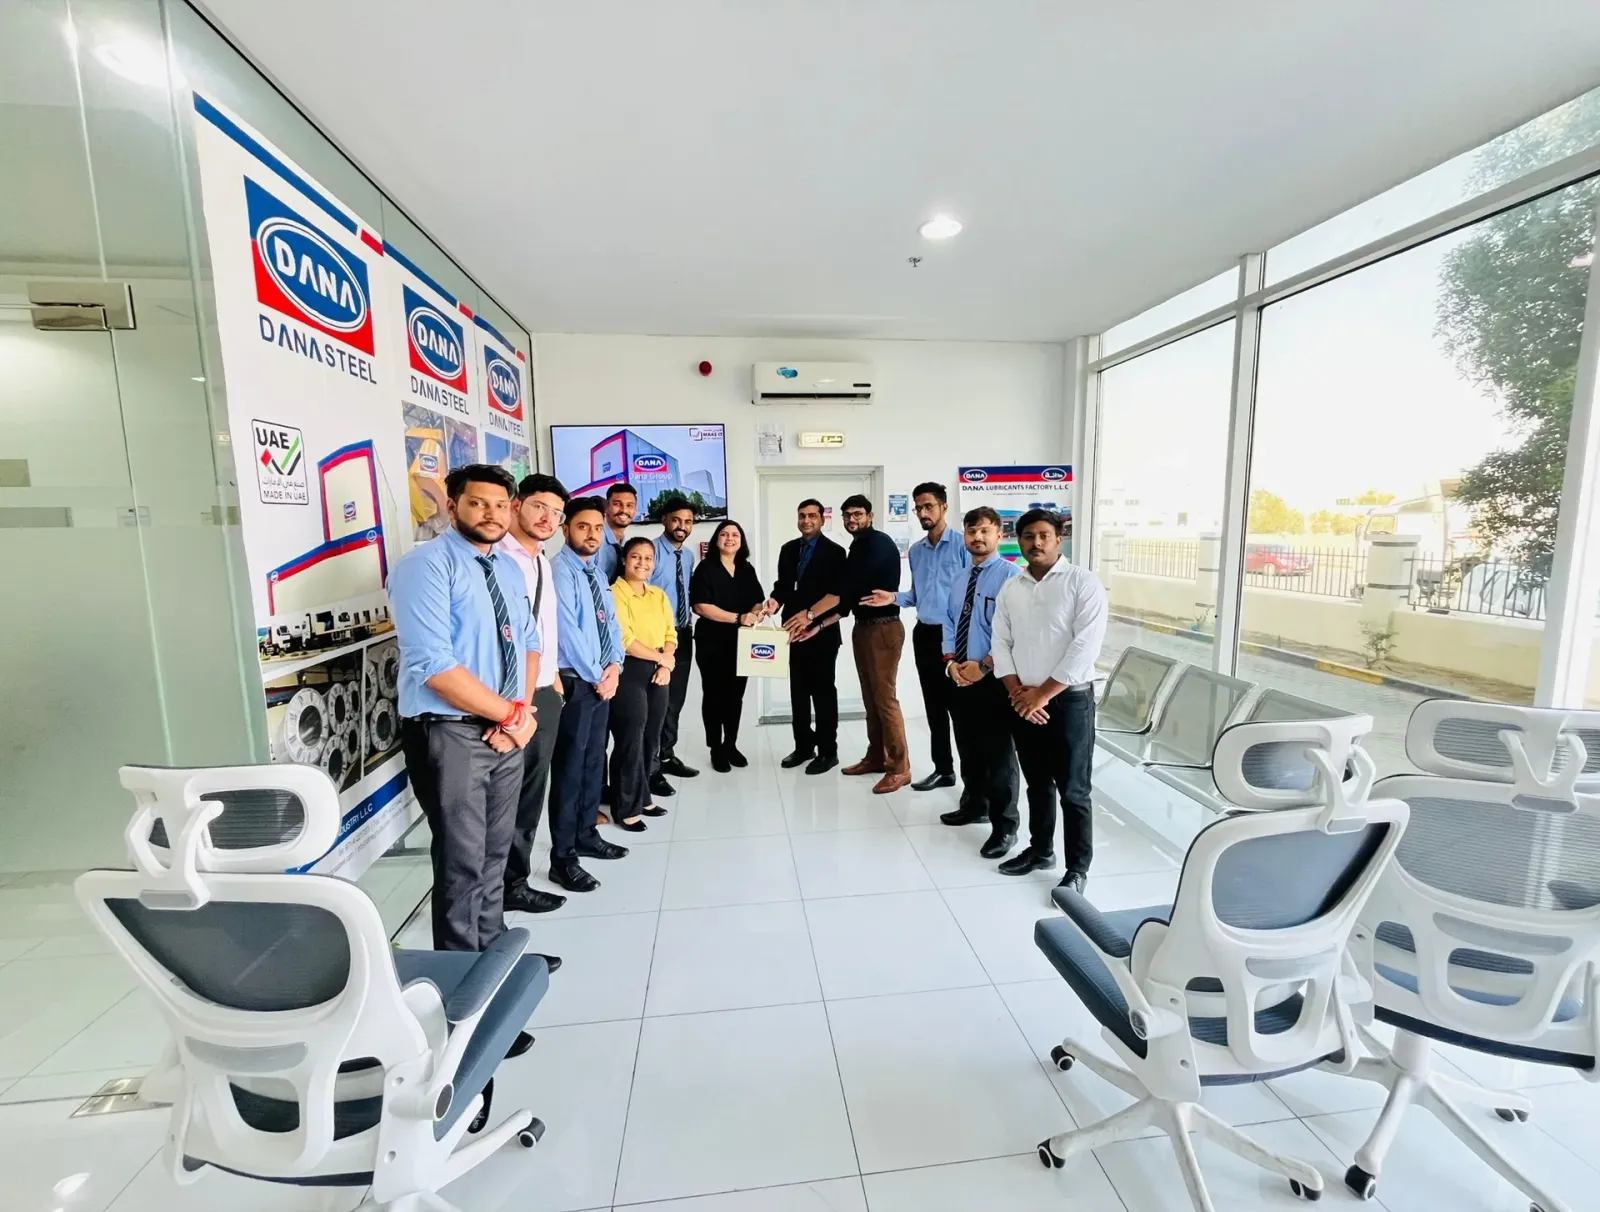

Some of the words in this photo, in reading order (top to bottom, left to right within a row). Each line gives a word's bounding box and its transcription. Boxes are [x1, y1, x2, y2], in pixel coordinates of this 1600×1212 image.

[274, 236, 357, 314] DANA
[417, 320, 459, 366] DANA
[255, 427, 290, 450] UAE
[649, 473, 673, 481] Group
[263, 490, 283, 500] MADE
[285, 491, 293, 500] IN
[294, 492, 306, 501] UAE
